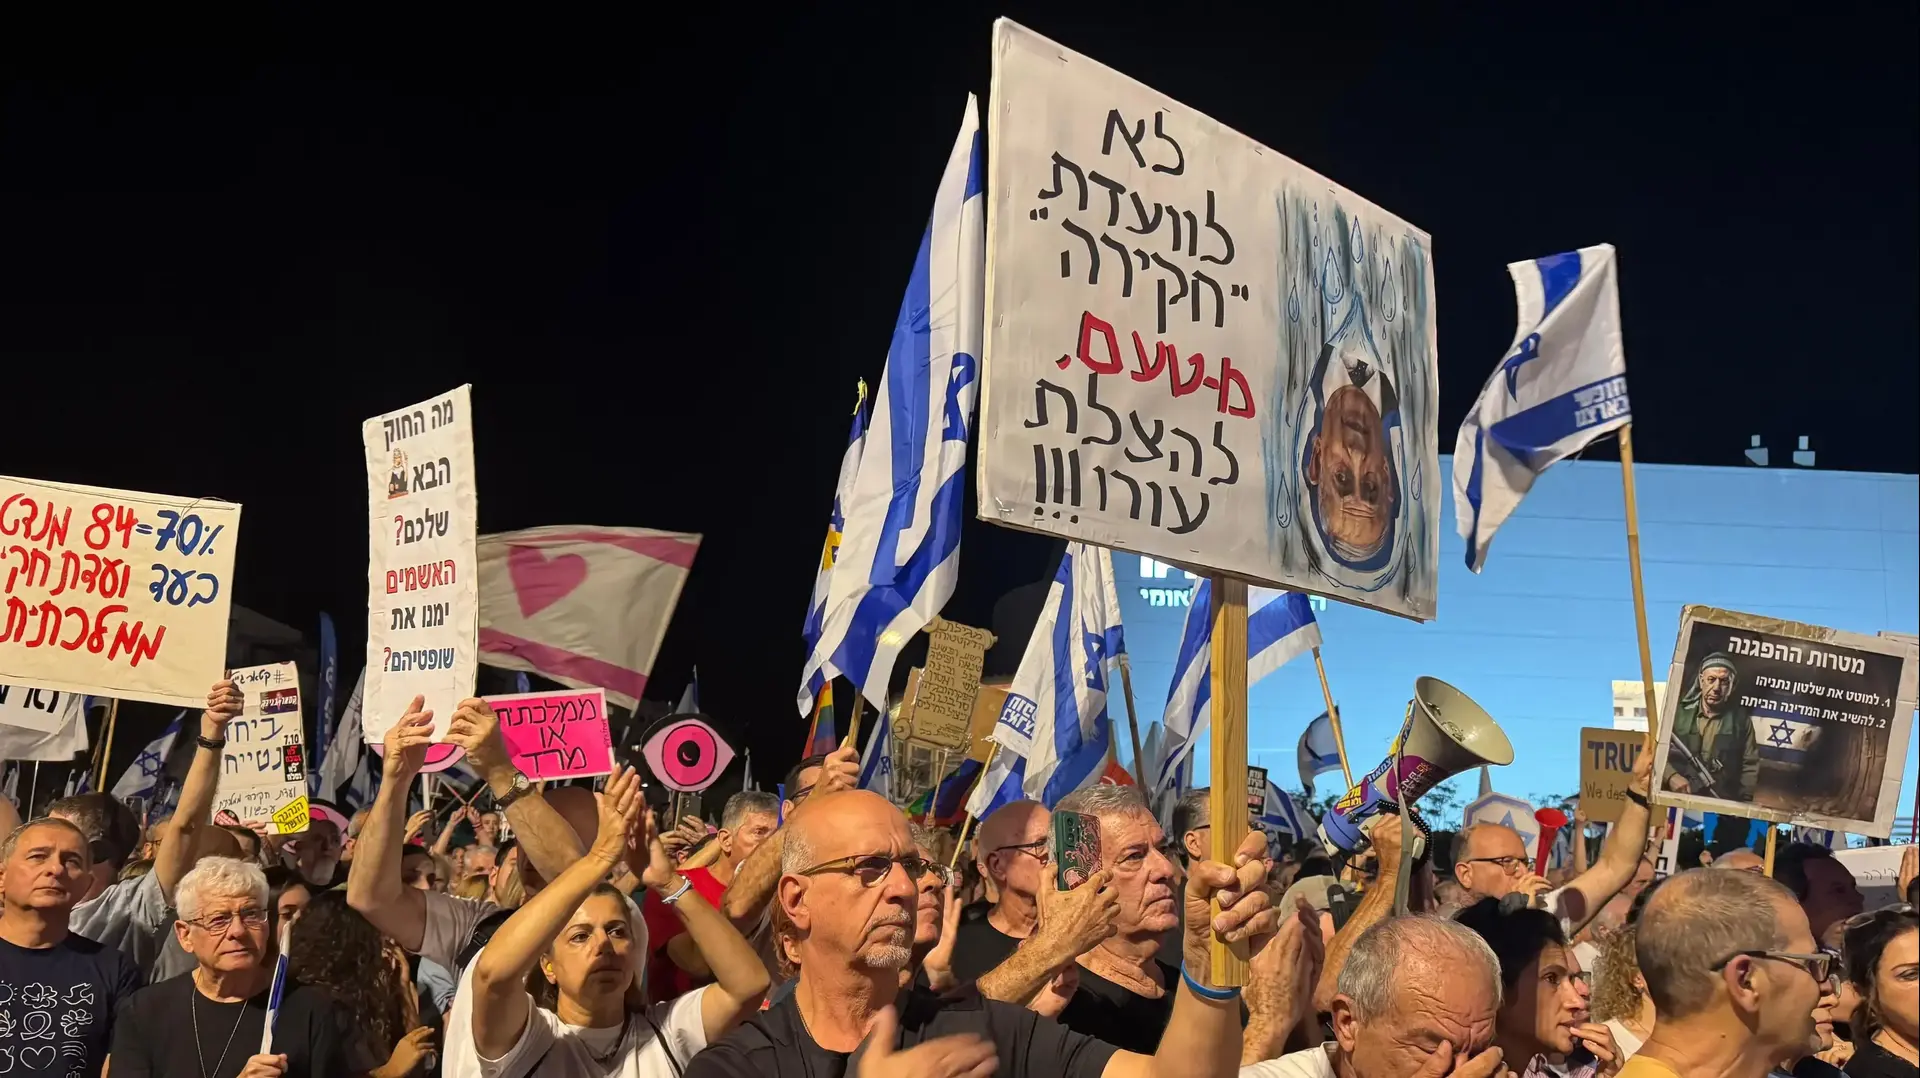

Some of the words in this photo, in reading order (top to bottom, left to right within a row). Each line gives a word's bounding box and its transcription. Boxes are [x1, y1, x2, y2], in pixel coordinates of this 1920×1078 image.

[1102, 109, 1184, 175] לא
[1038, 151, 1235, 265] לוועדת
[431, 398, 454, 428] מה
[384, 412, 425, 452] החוק
[1025, 372, 1239, 485] להצלת
[412, 456, 451, 492] הבא
[394, 508, 449, 546] שלכם?
[50, 550, 131, 598] ועדת
[149, 565, 218, 608] בעד
[386, 559, 456, 595] האשמים
[1139, 585, 1193, 607] אומי
[391, 605, 416, 630] את
[422, 602, 449, 627] ימנו
[0, 597, 167, 667] ממלכתית
[384, 647, 454, 672] שופטיהם?
[1728, 636, 1802, 663] ההפגנה
[1807, 651, 1866, 675] מטרות
[1756, 675, 1791, 691] נתניהו
[1792, 681, 1825, 697] שלטון
[1826, 687, 1844, 700] את
[1740, 695, 1778, 712] הביתה
[1846, 689, 1880, 706] למוטט
[1780, 704, 1819, 718] המדינה
[1822, 708, 1839, 721] את
[1842, 711, 1875, 727] להשיב
[540, 723, 567, 748] או
[520, 746, 588, 774] מרד
[1587, 740, 1643, 773] TRU
[1585, 781, 1602, 799] We
[1606, 783, 1626, 801] des
